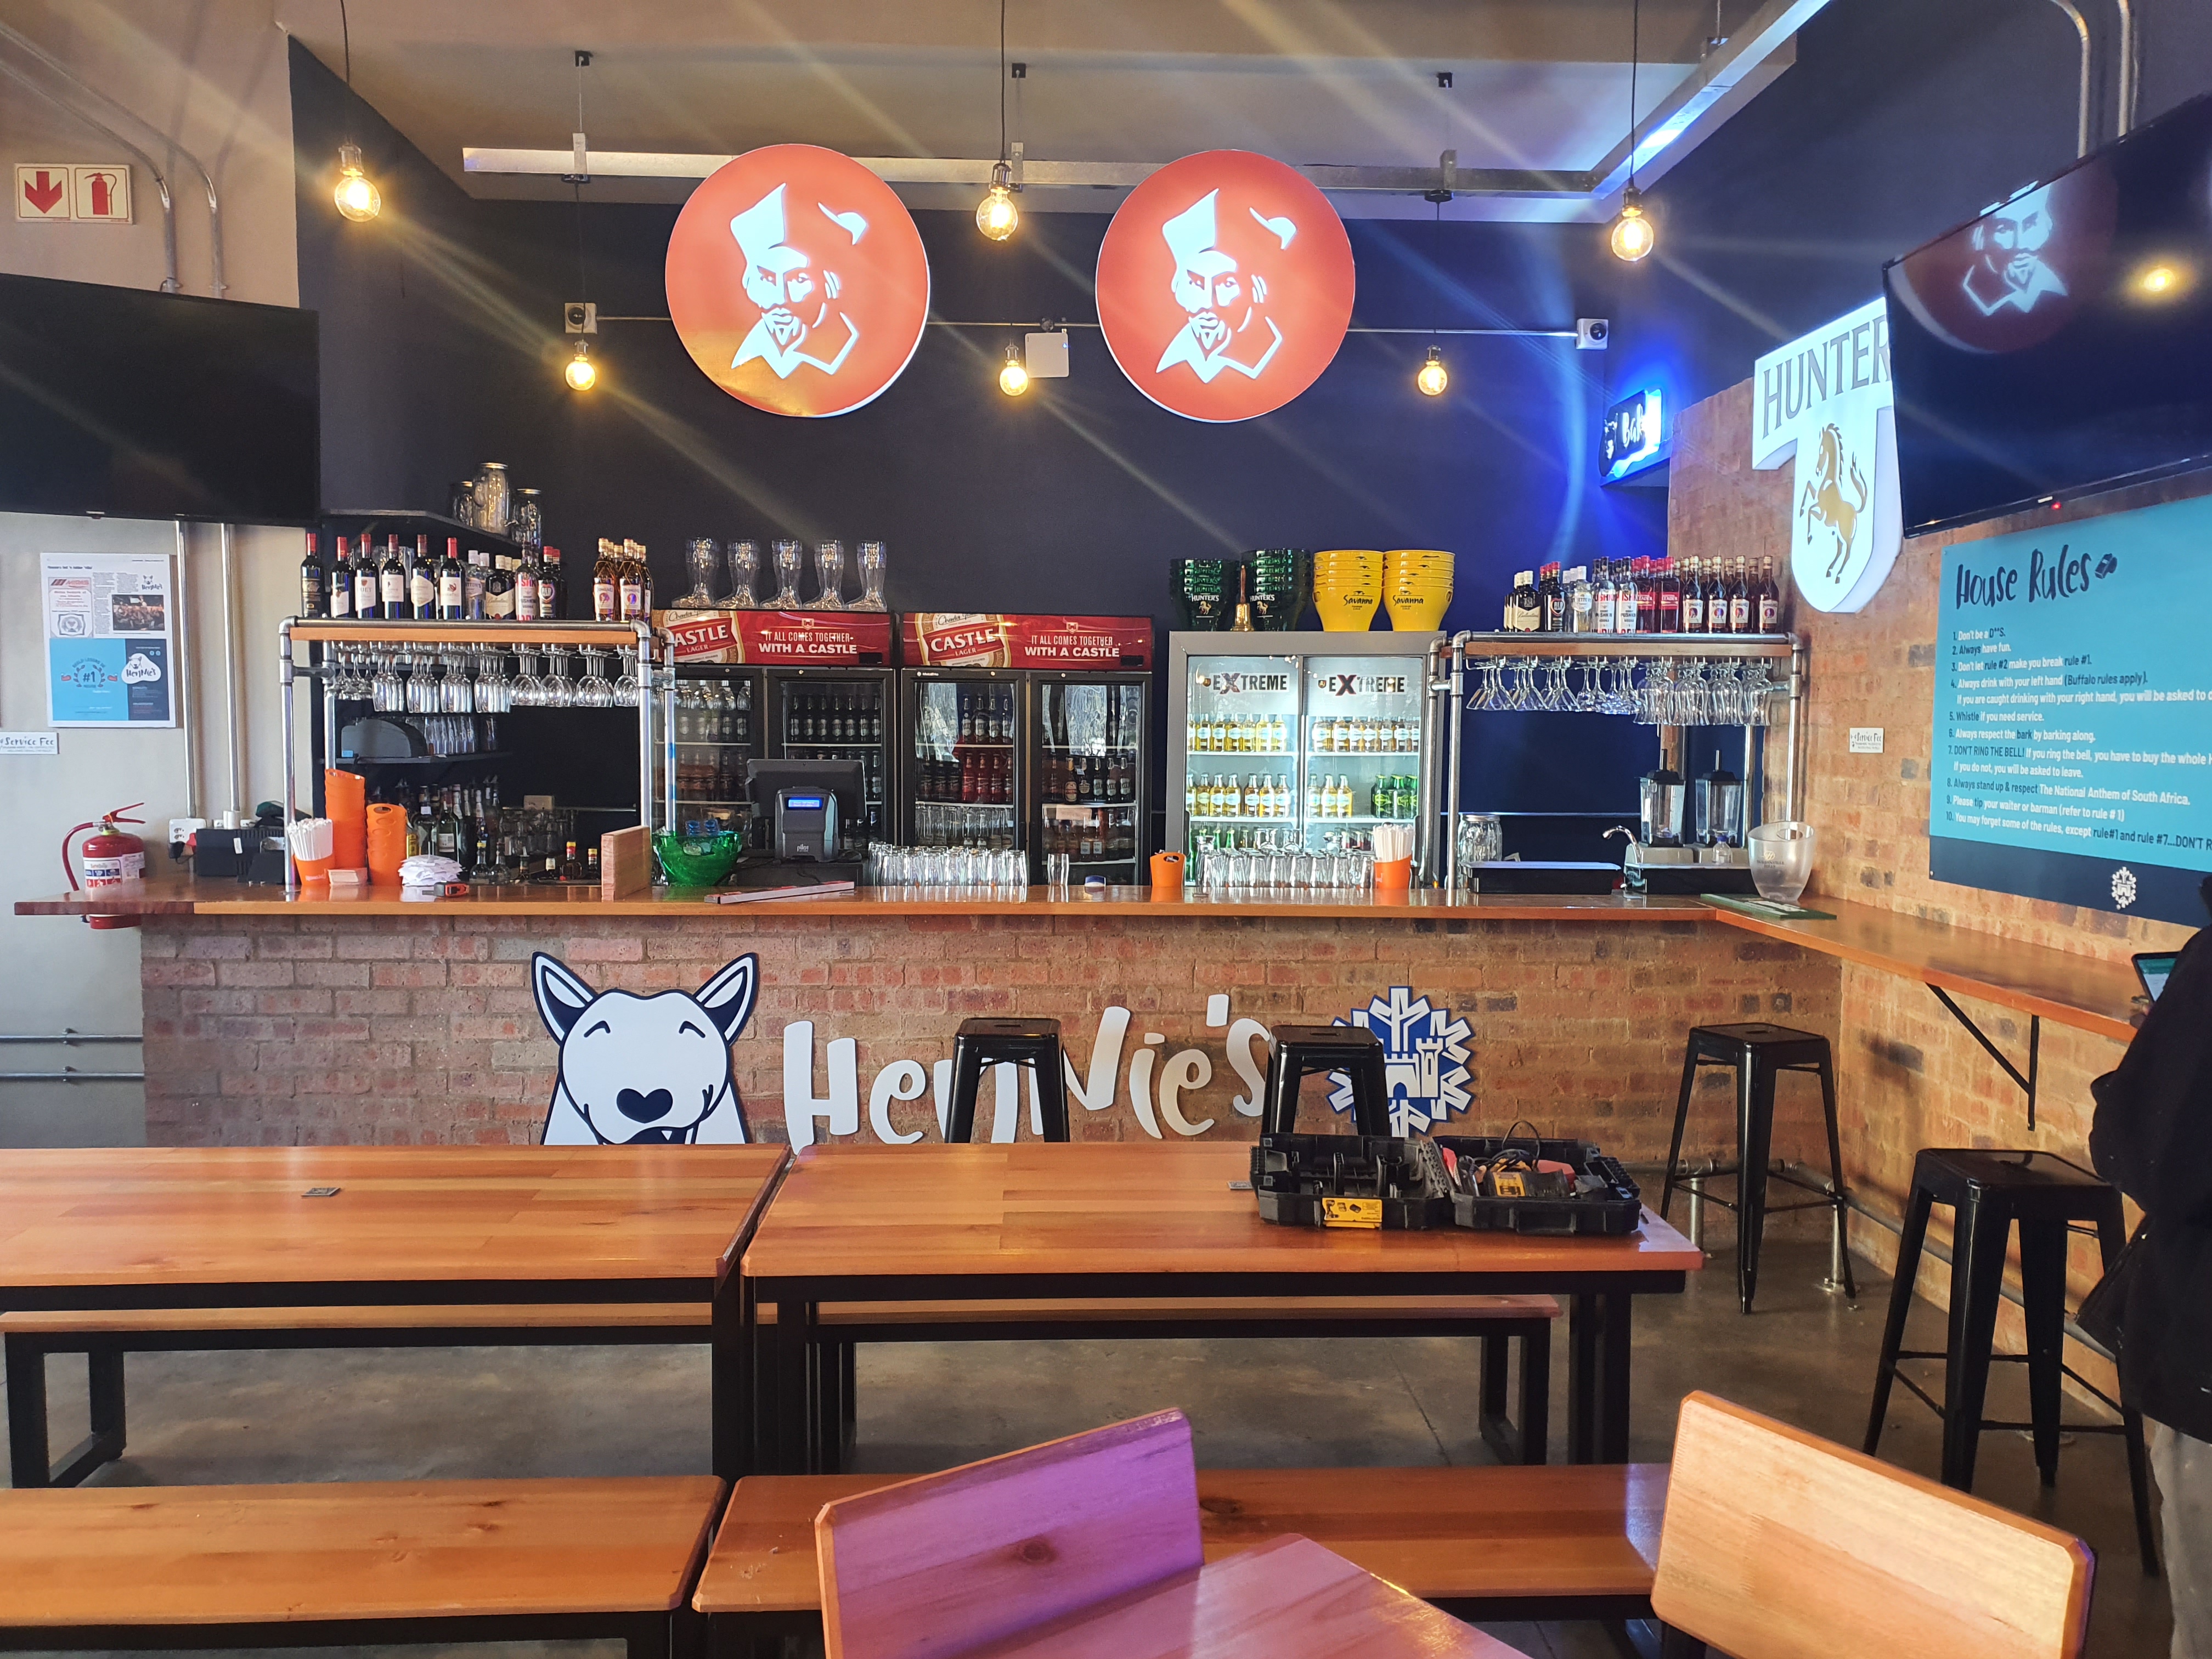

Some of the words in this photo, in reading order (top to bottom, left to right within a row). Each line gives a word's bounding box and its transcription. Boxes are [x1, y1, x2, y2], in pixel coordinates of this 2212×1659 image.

[1956, 564, 2017, 609] House
[2029, 544, 2092, 602] Rules
[1344, 595, 1373, 606] Savanna
[1393, 595, 1424, 606] Savanna
[674, 625, 729, 647] ASTLE
[774, 632, 786, 641] ALL
[788, 633, 812, 641] COMES
[816, 633, 850, 642] TOGETHER
[931, 629, 996, 652] CASTLE
[1031, 635, 1037, 644] IT
[1040, 636, 1051, 645] ALL
[1054, 636, 1077, 645] COMES
[1080, 636, 1113, 646] TOGETHER
[1959, 630, 1974, 641] Don't
[1976, 630, 1983, 639] be
[686, 644, 709, 652] LAGER
[759, 643, 791, 653] WITH
[795, 644, 805, 653] A
[809, 644, 857, 653] CASTLE
[955, 648, 977, 656] LAGER
[1025, 647, 1056, 656] WITH
[1060, 647, 1069, 656] A
[1073, 647, 1119, 657] CASTLE
[1953, 646, 1957, 655] 2.
[1960, 645, 1980, 656] Always
[1982, 644, 1997, 653] have
[1999, 642, 2011, 652] fun.
[1951, 663, 1957, 672] 3.
[1959, 662, 1974, 672] Don't
[1976, 662, 1984, 670] let
[1985, 661, 1997, 670] rule
[1999, 659, 2007, 669] #2
[2009, 658, 2027, 669] make
[2028, 659, 2041, 670] you
[2042, 656, 2063, 667] break
[2064, 656, 2079, 666] rule
[2081, 654, 2092, 665] #1.
[83, 671, 95, 682] #1
[1214, 673, 1287, 694] EXTREME
[1951, 680, 1956, 689] 4.
[1958, 679, 1979, 690] Always
[1981, 678, 1997, 688] drink
[1999, 677, 2013, 687] with
[2015, 678, 2030, 689] your
[2032, 675, 2043, 686] left
[2045, 675, 2063, 685] hand
[2064, 674, 2096, 686] (Buffalo
[2098, 673, 2118, 684] rules
[2119, 671, 2148, 686] apply).
[1957, 695, 1962, 704] If
[1963, 697, 1974, 706] you
[1976, 696, 1985, 704] are
[1987, 694, 2009, 706] caught
[2011, 693, 2038, 706] drinking
[2040, 692, 2056, 703] with
[2057, 693, 2073, 706] your
[2075, 692, 2094, 705] right
[2119, 692, 2135, 704] you
[2137, 690, 2152, 701] will
[2153, 690, 2165, 701] be
[2166, 689, 2194, 701] asked
[2196, 689, 2206, 701] to
[1949, 712, 1955, 721] 5.
[1956, 712, 1979, 721] Whistle
[1980, 711, 1985, 721] if
[1987, 713, 1998, 723] you
[1999, 712, 2016, 721] need
[2017, 712, 2044, 721] service.
[5, 736, 36, 745] Service
[40, 737, 53, 746] Fee
[1949, 729, 1954, 737] 6.
[1956, 729, 1977, 740] Always
[1979, 730, 2003, 741] respect
[2005, 730, 2015, 739] the
[2017, 730, 2032, 740] bark
[2034, 730, 2041, 742] by
[2044, 730, 2070, 743] barking
[2072, 730, 2096, 743] along.
[1948, 746, 1953, 754] 7.
[1954, 746, 1972, 755] DON'T
[1974, 746, 1989, 756] RING
[1990, 747, 2003, 757] THE
[2005, 747, 2024, 757] BELL!
[2026, 748, 2032, 758] If
[2033, 750, 2045, 760] you
[2046, 748, 2061, 761] ring
[2063, 748, 2074, 760] the
[2094, 752, 2109, 763] you
[2111, 751, 2130, 761] have
[2132, 752, 2141, 762] to
[2143, 752, 2159, 765] buy
[2161, 752, 2176, 763] the
[2177, 752, 2206, 765] whole
[1954, 761, 1959, 771] If
[1960, 763, 1971, 773] you
[1972, 762, 1979, 772] do
[1980, 763, 1992, 773] not,
[1994, 764, 2006, 775] you
[2007, 764, 2019, 774] will
[2021, 764, 2029, 775] be
[2030, 765, 2051, 776] asked
[2052, 766, 2060, 776] to
[2062, 766, 2083, 777] leave.
[1948, 778, 1952, 787] 8.
[1954, 778, 1975, 789] Always
[1977, 781, 1994, 791] stand
[1996, 783, 2004, 793] up
[2005, 782, 2010, 791] &
[2012, 784, 2038, 795] respect
[2040, 783, 2052, 795] The
[2054, 785, 2086, 798] National
[2088, 787, 2120, 800] Anthem
[2121, 789, 2131, 800] of
[2132, 790, 2158, 803] South
[2159, 792, 2191, 805] Africa.
[1946, 795, 1951, 804] 9.
[1953, 795, 1973, 806] Please
[1974, 797, 1983, 809] tip
[1984, 800, 1998, 810] your
[2000, 800, 2020, 811] waiter
[2022, 803, 2029, 811] or
[2030, 803, 2057, 815] barman
[2059, 804, 2080, 816] (refer
[2083, 808, 2090, 817] to
[2092, 808, 2107, 819] rule
[1955, 812, 1966, 822] You
[1967, 816, 1980, 826] may
[1982, 815, 2001, 828] forget
[2002, 819, 2020, 828] some
[2022, 819, 2029, 830] of
[2030, 820, 2042, 831] the
[2044, 822, 2063, 834] rules,
[2065, 826, 2092, 838] except
[2120, 831, 2135, 842] and
[2137, 832, 2154, 844] rule
